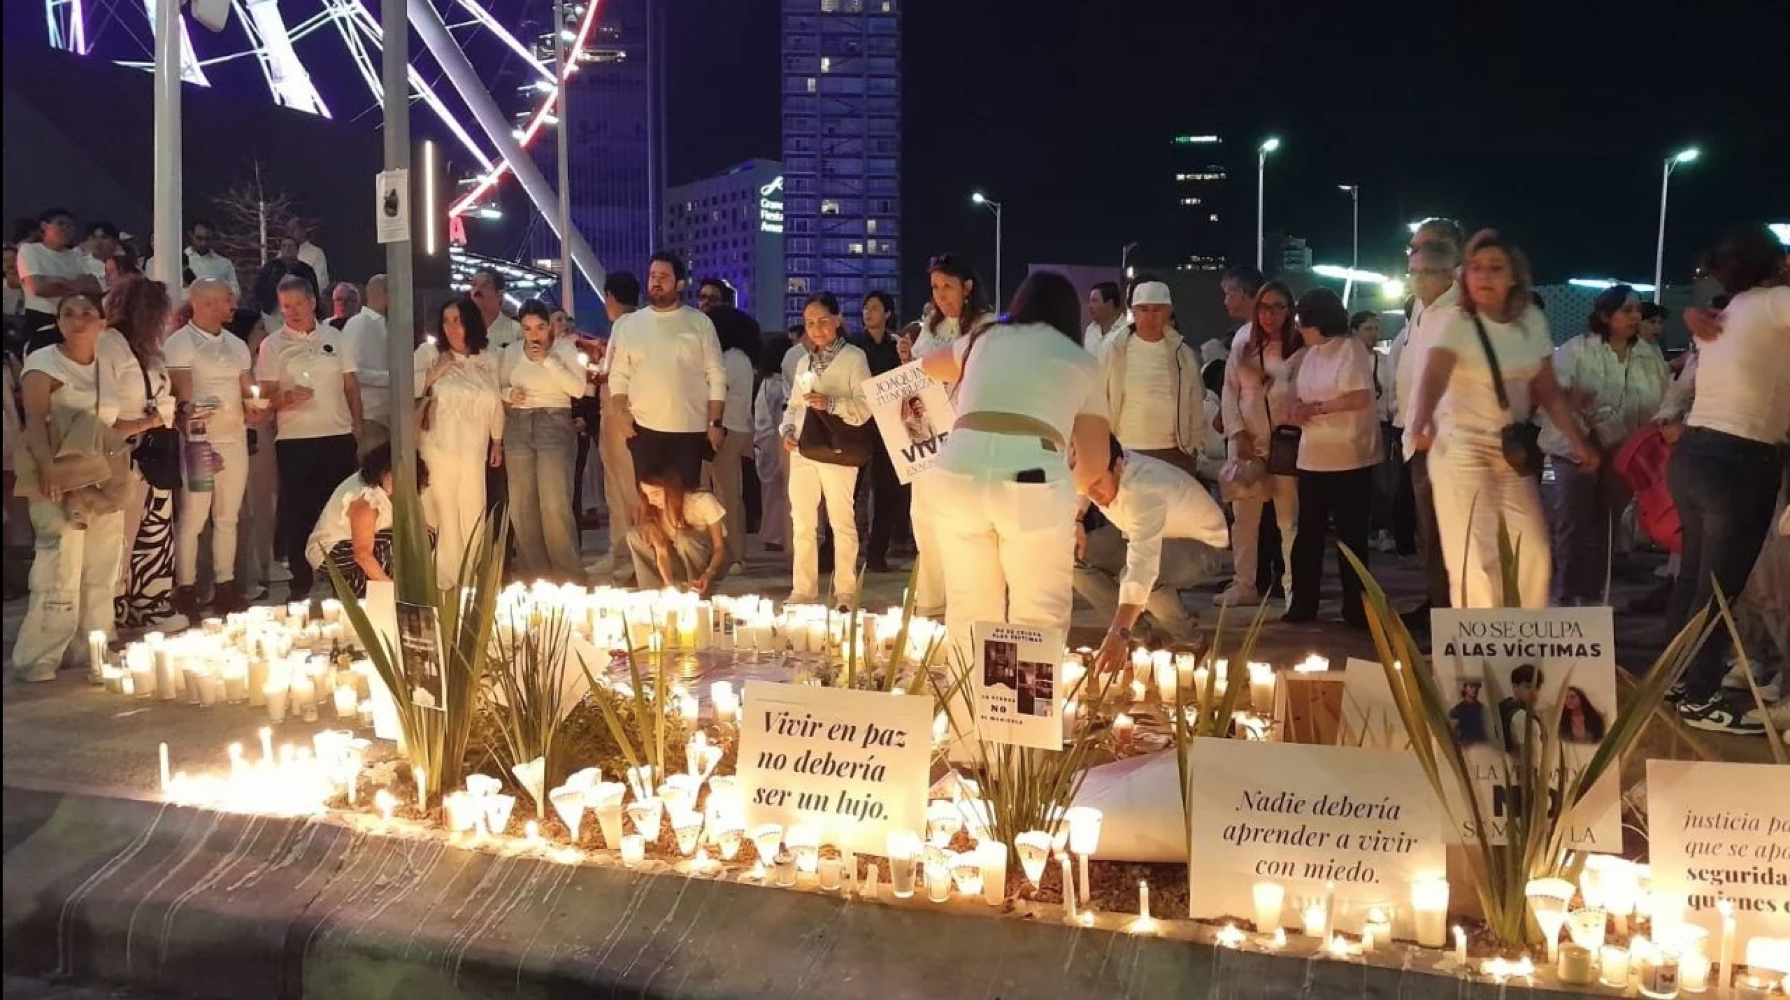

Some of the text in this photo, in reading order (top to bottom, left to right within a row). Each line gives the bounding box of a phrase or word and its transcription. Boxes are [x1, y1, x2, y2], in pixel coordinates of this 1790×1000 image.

[1458, 620, 1583, 638] NO SE CULPA
[1444, 638, 1602, 658] A LAS VÍCTIMAS
[990, 705, 1007, 713] NO
[764, 711, 908, 749] Vivir en paz
[757, 749, 886, 783] no debería
[753, 785, 889, 822] ser un lujo.
[1235, 790, 1401, 821] Nadie debería
[1684, 809, 1761, 831] justicia
[1222, 821, 1418, 854] aprender a vivir
[1684, 840, 1723, 858] que
[1728, 843, 1749, 857] se
[1255, 858, 1380, 884] con miedo.
